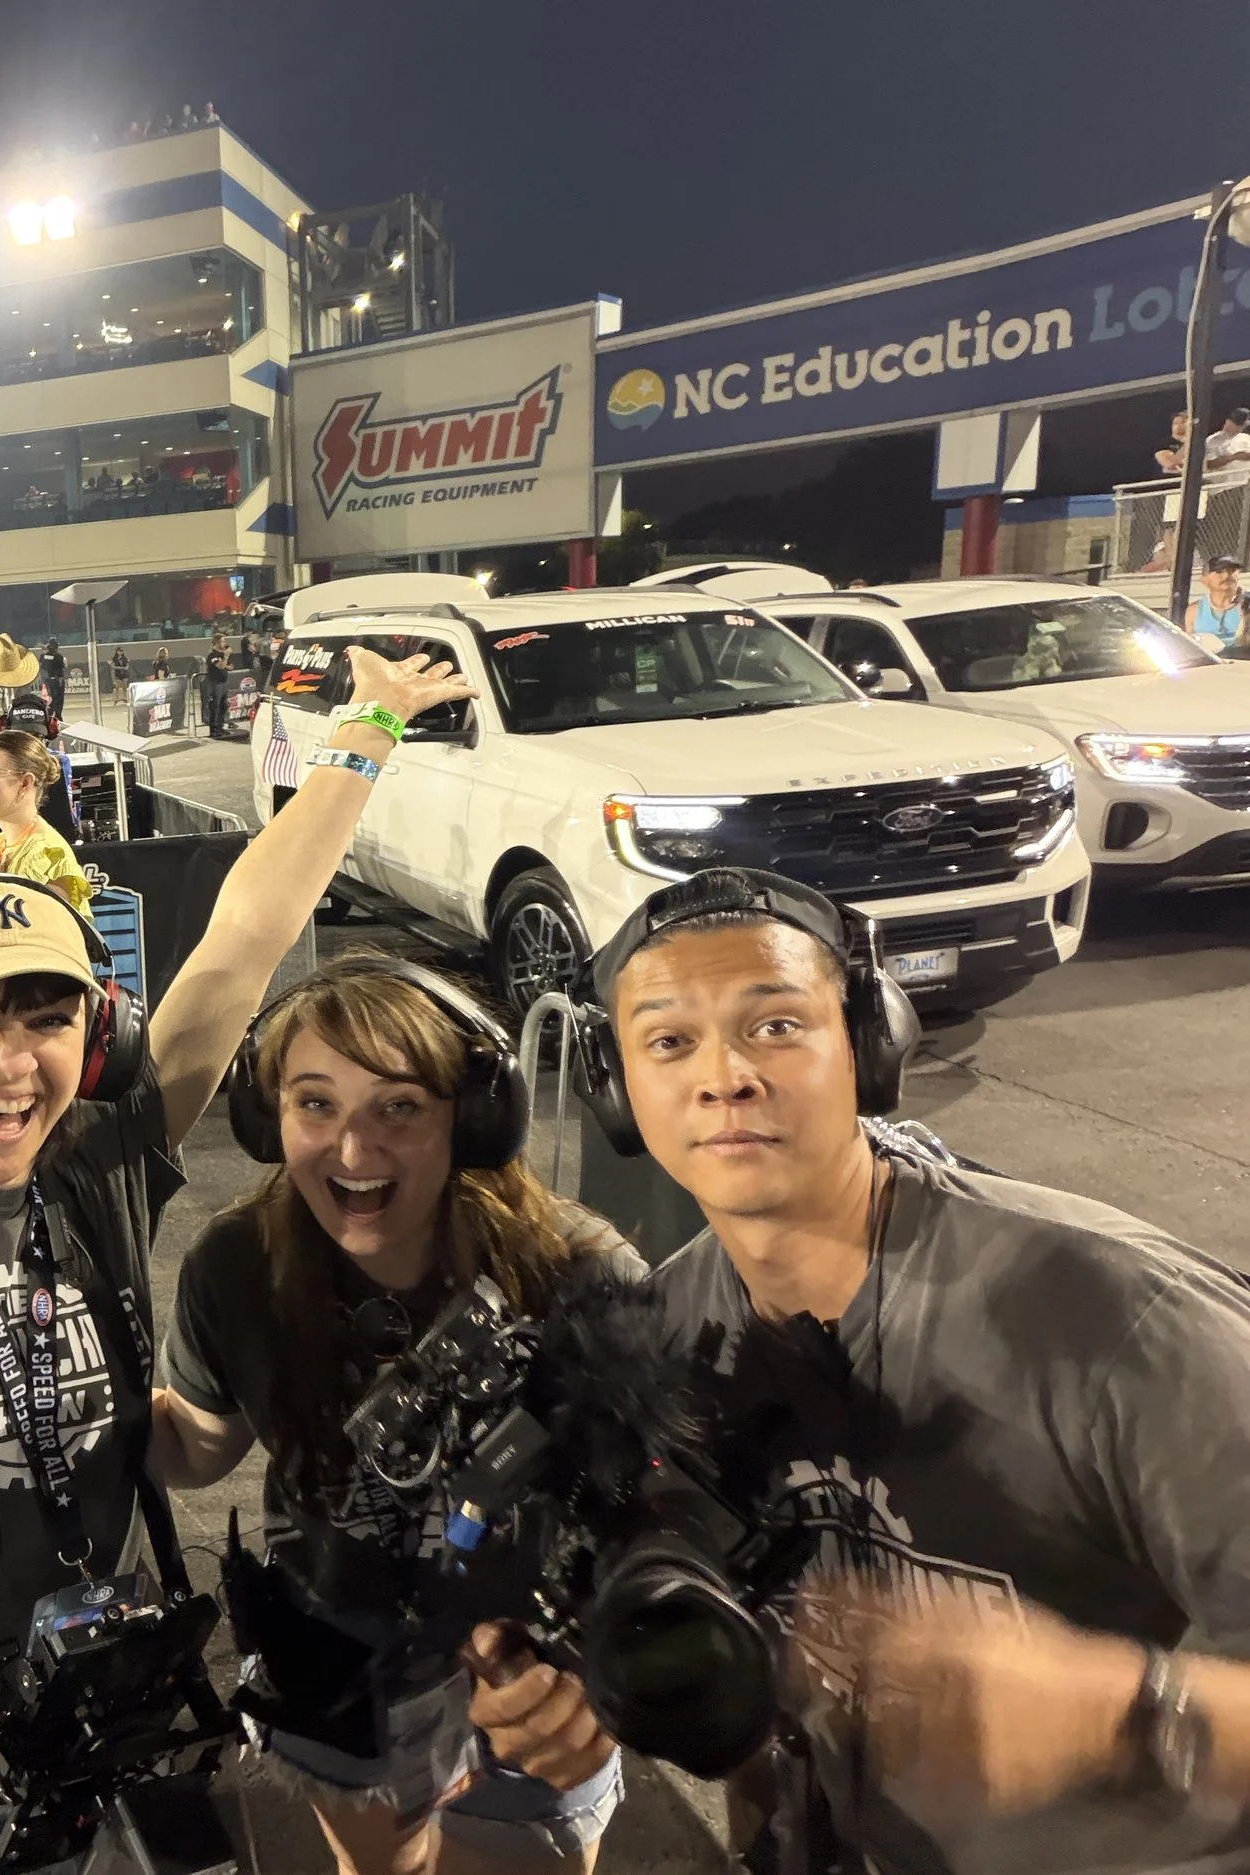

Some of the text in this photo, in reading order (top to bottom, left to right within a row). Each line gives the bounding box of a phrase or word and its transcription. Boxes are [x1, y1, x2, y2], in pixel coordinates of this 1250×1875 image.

[673, 362, 751, 419] NC
[761, 307, 1074, 405] Education
[346, 478, 539, 513] RACING EQUIPMENT
[585, 614, 688, 631] MILLICAN
[787, 756, 1007, 788] EXPEDITION
[896, 956, 939, 976] PLANET
[31, 1352, 70, 1492] SPEED FOR ALL
